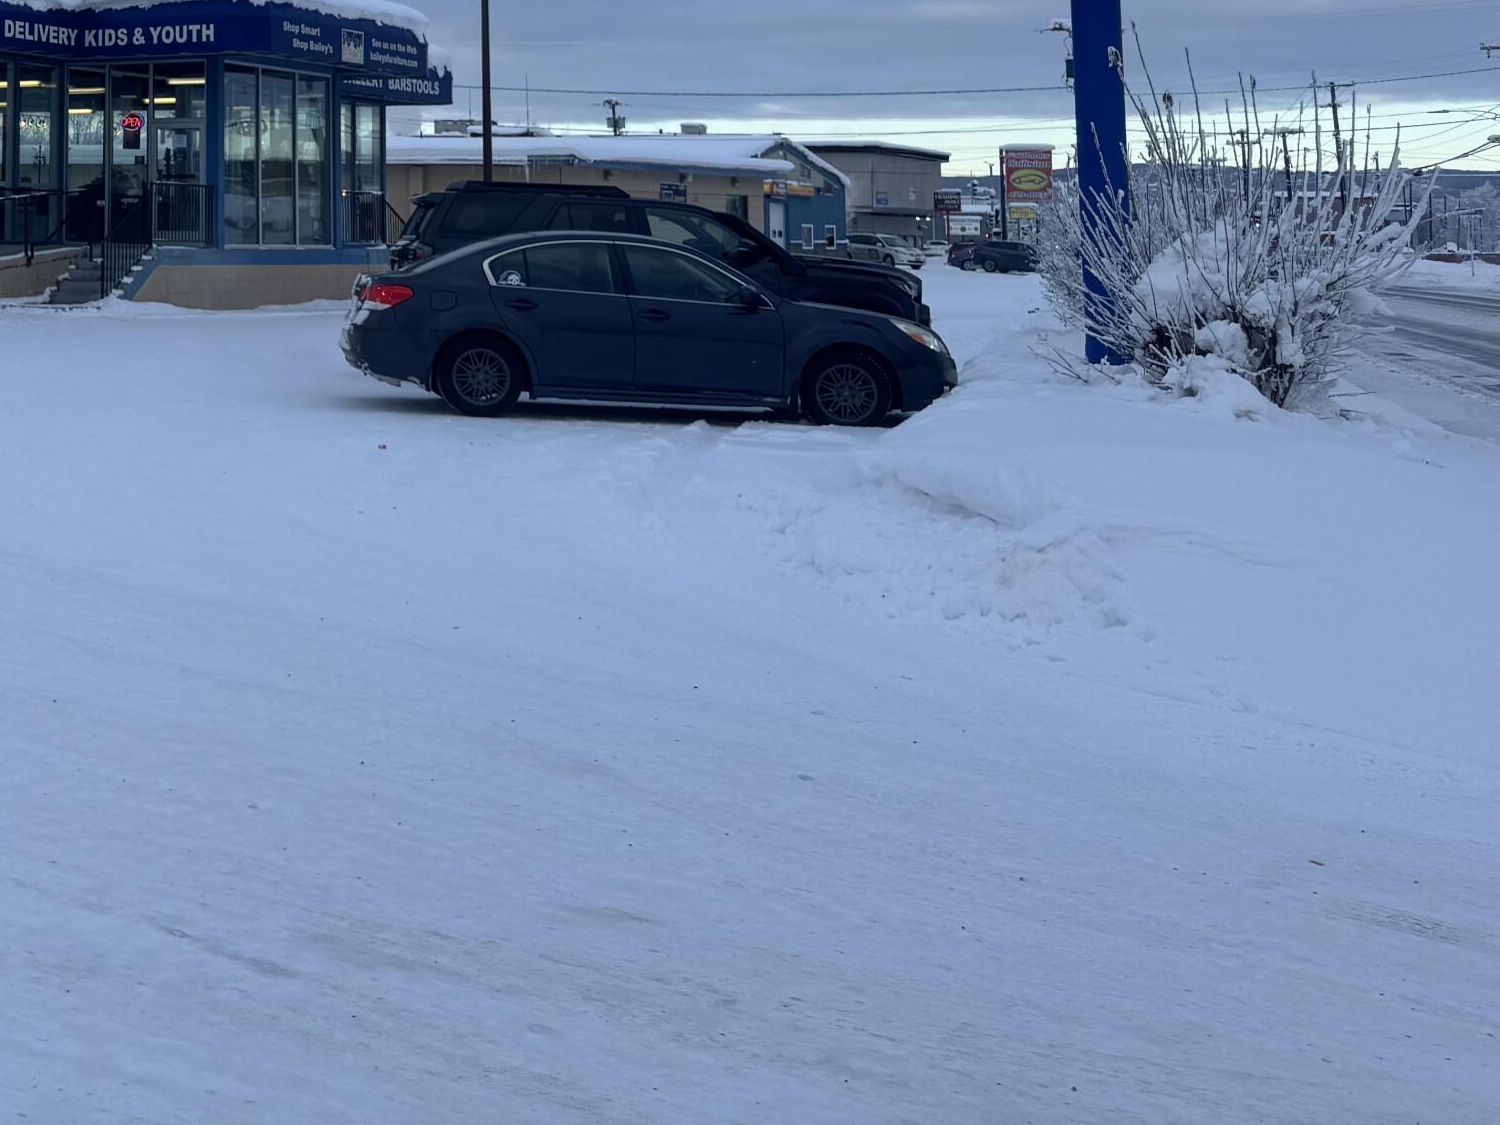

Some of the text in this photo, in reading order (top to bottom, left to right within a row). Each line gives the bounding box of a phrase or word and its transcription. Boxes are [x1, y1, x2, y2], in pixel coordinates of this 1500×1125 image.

[4, 19, 78, 46] DELIVERY
[84, 23, 215, 47] KIDS & YOUTH
[283, 21, 321, 36] Shop Smart
[292, 38, 334, 55] Shop Bailey's
[387, 77, 440, 96] BARSTOOLS
[121, 117, 141, 127] OPEN
